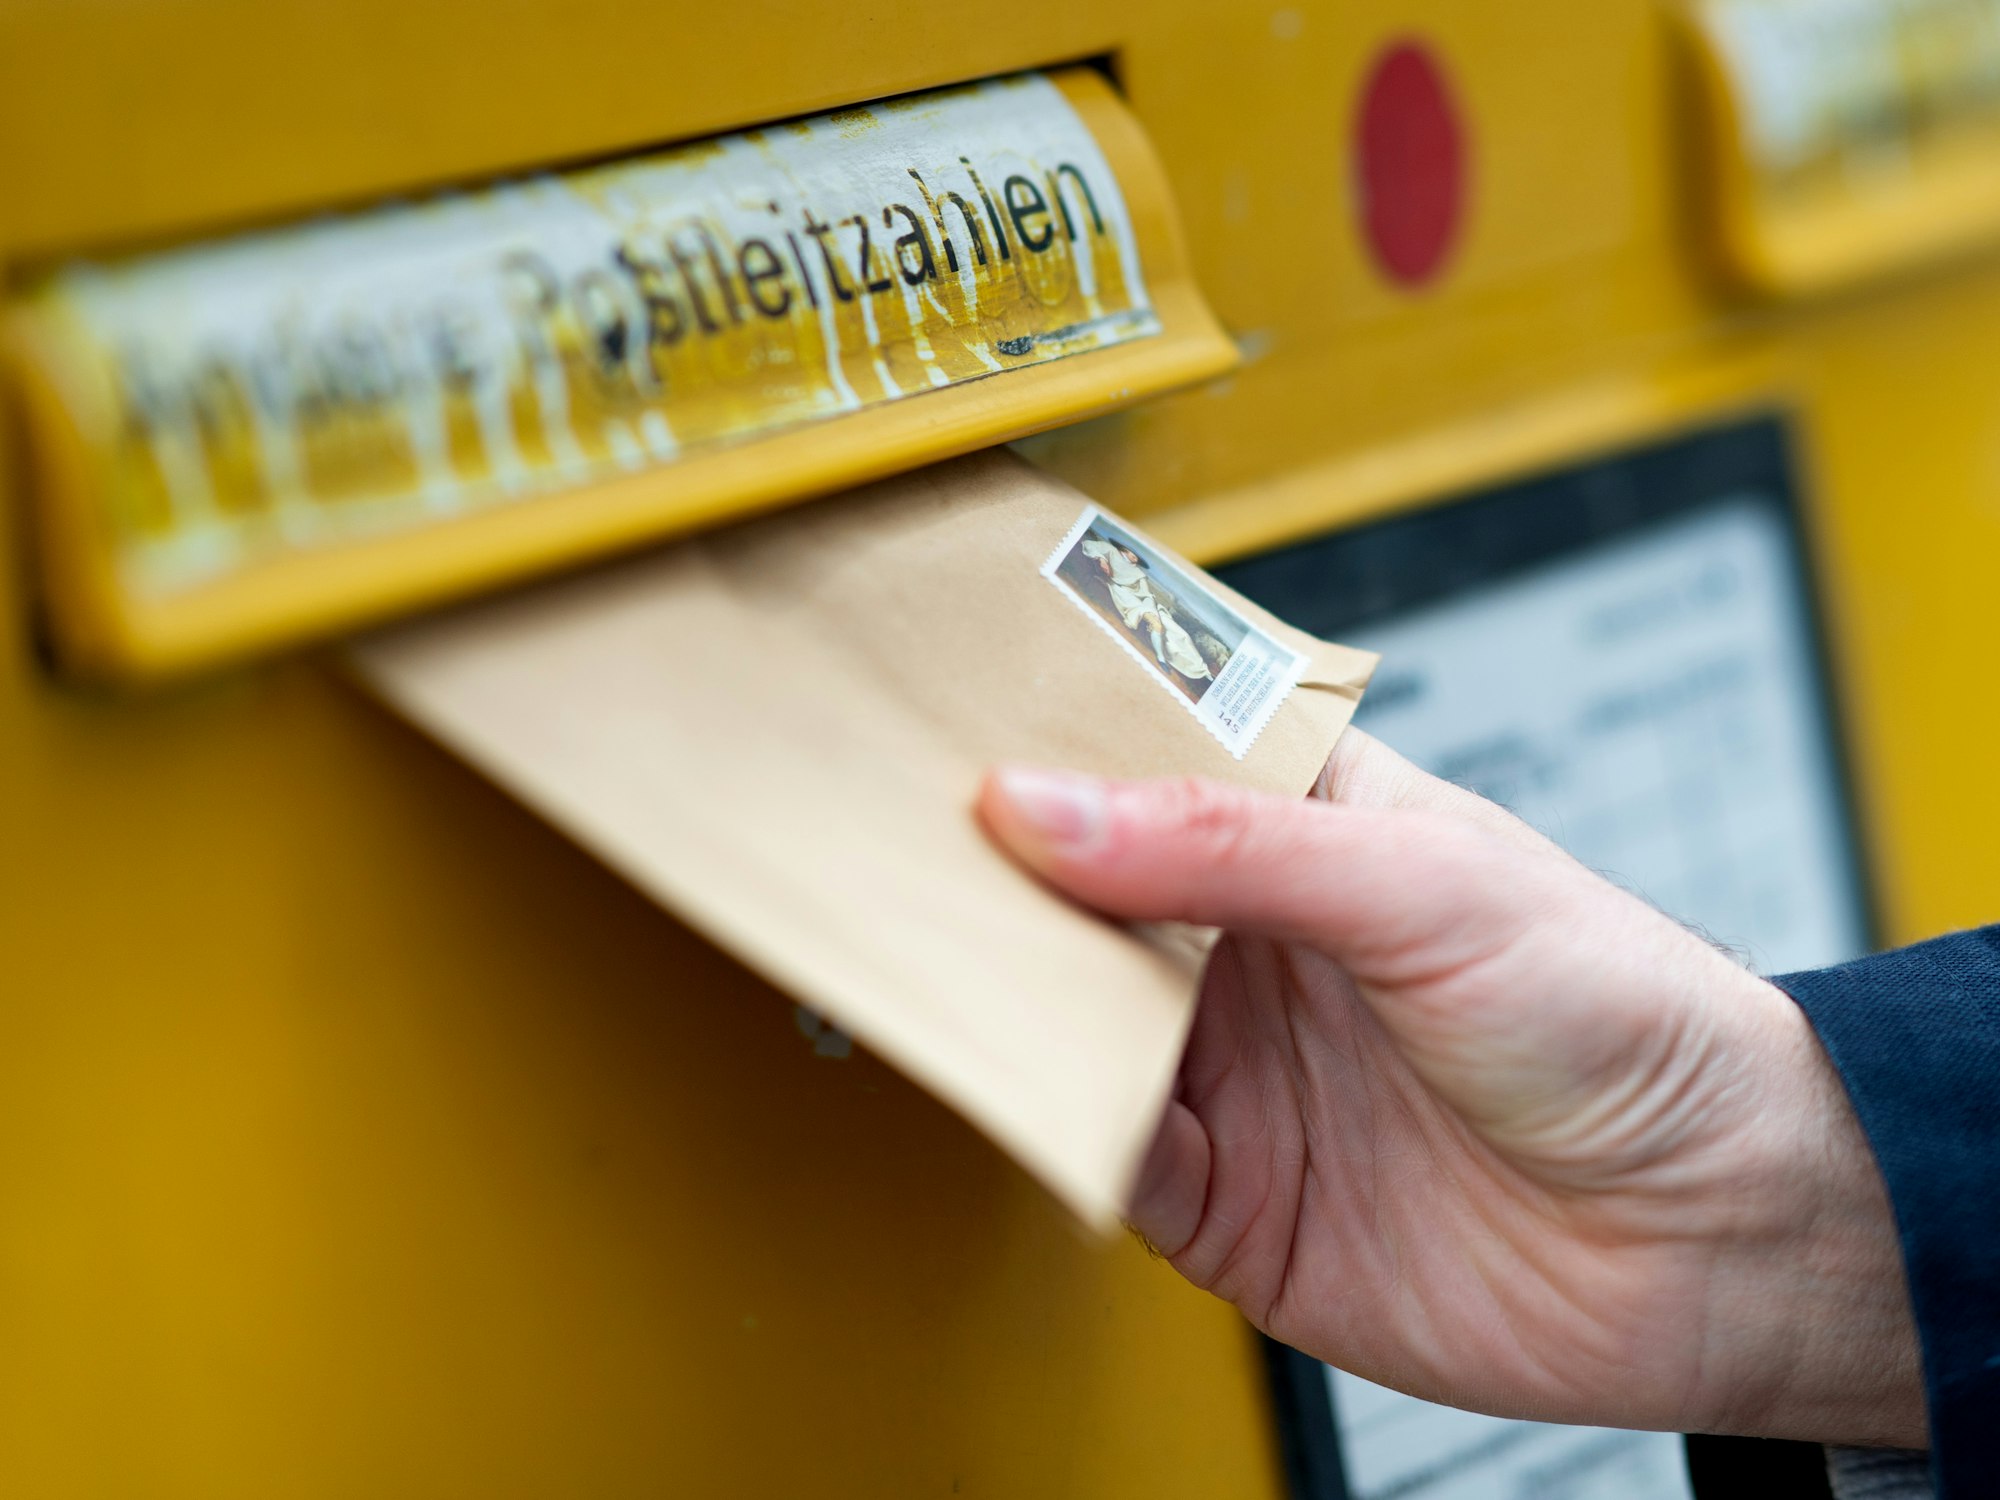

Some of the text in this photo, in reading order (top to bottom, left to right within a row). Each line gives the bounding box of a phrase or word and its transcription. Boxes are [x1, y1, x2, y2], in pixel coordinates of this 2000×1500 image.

[498, 155, 1105, 388] Postleitzahlen
[1219, 681, 1241, 707] WILHELM
[1228, 693, 1247, 716] GOETHE
[1247, 676, 1259, 690] DER
[1244, 675, 1276, 715] DEUTSCHLAND
